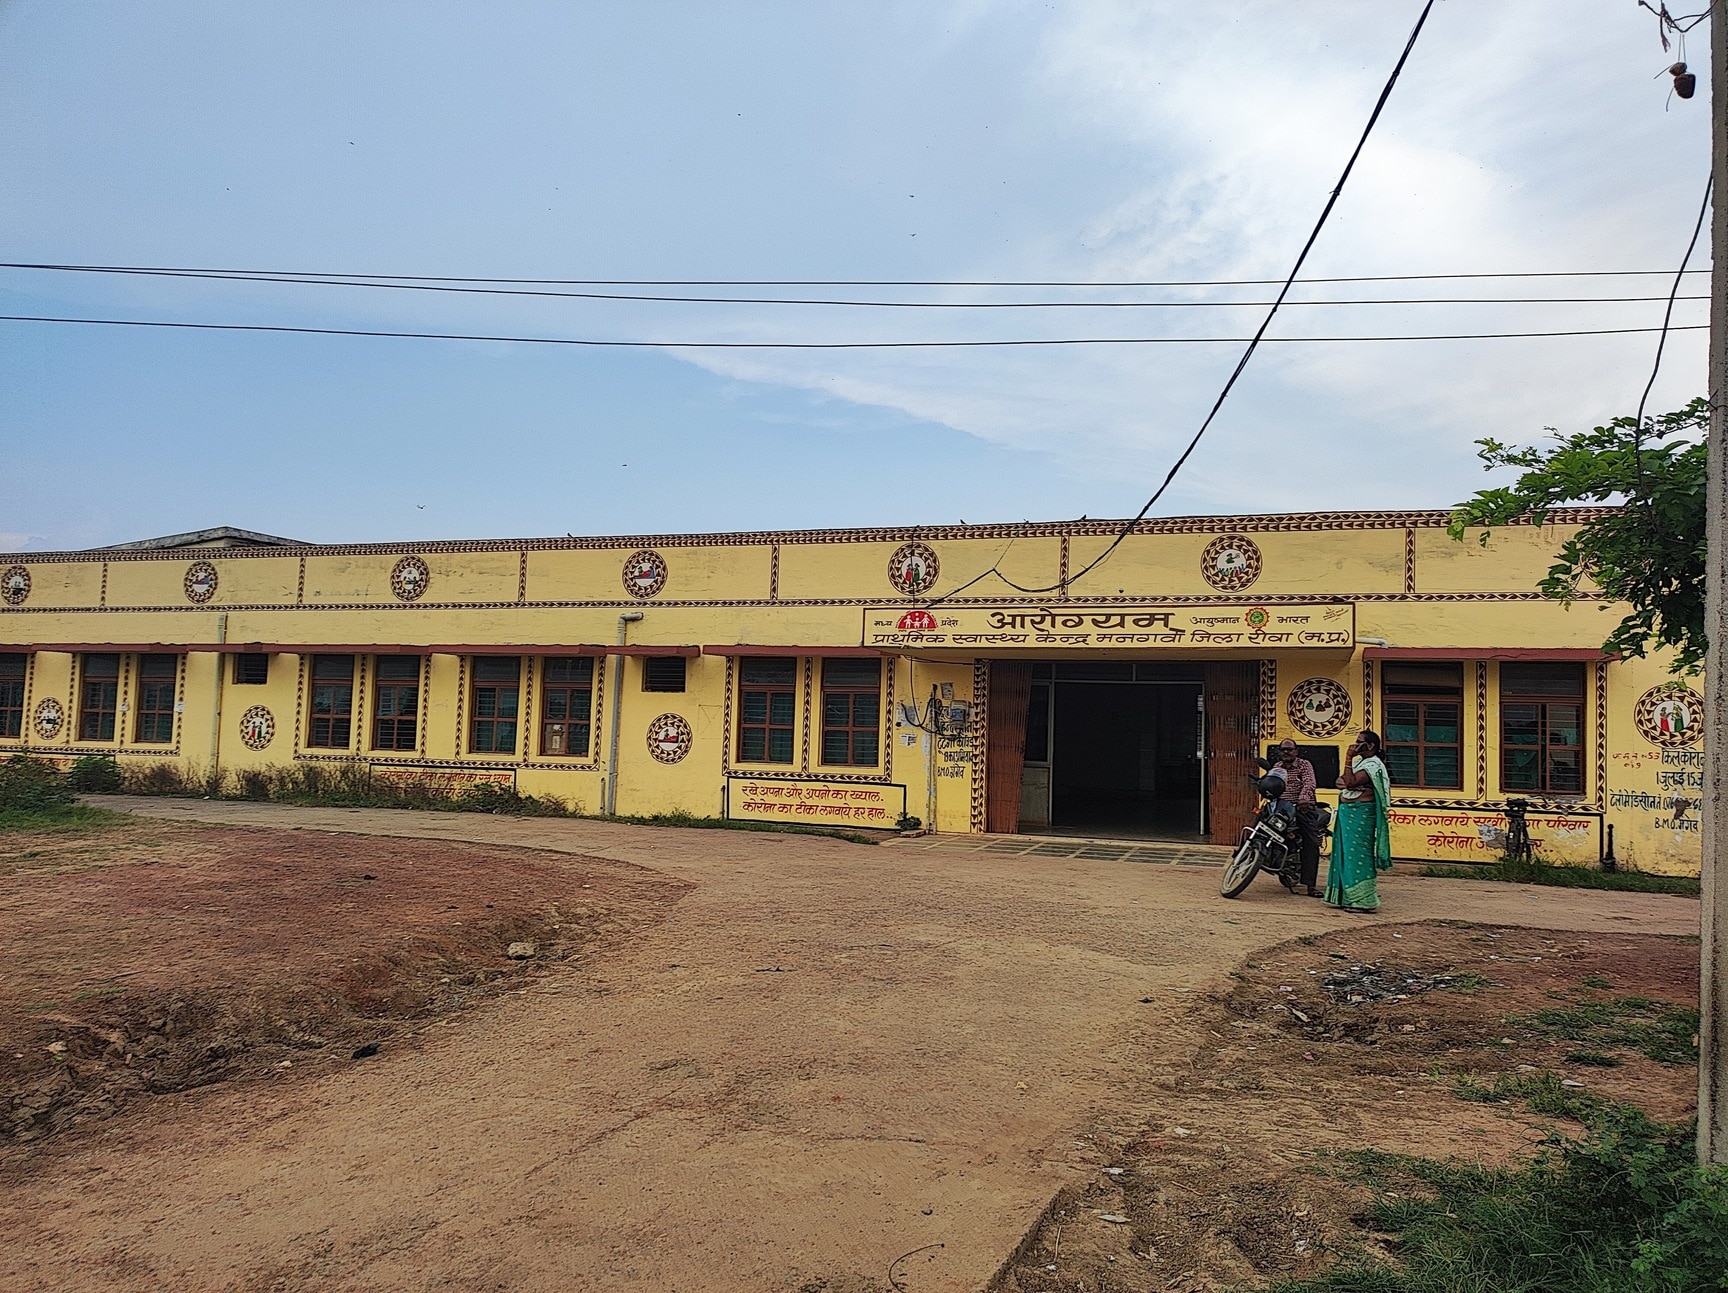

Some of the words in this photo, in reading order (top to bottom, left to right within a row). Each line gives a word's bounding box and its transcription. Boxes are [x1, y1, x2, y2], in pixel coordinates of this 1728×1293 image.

[873, 620, 893, 628] मध्य
[940, 617, 959, 628] प्रदेश
[986, 607, 1185, 634] आरोग्यम्
[1189, 615, 1241, 627] आयुष्मान
[1276, 615, 1311, 625] भारत
[871, 630, 948, 645] प्राथमिक
[952, 632, 1030, 645] स्वास्थ्य
[1035, 630, 1092, 646] केन्द्र
[1190, 630, 1245, 644] जिला
[1247, 629, 1294, 645] रीवा
[1297, 629, 1350, 646] (म.प्र.)
[760, 785, 785, 798] अपना
[784, 783, 803, 801] और
[831, 789, 849, 801] का
[742, 798, 777, 814] कोरोना
[777, 803, 795, 815] का
[795, 801, 820, 816] टीका
[1544, 815, 1592, 835] परिवार
[1426, 830, 1477, 851] कोरोना
